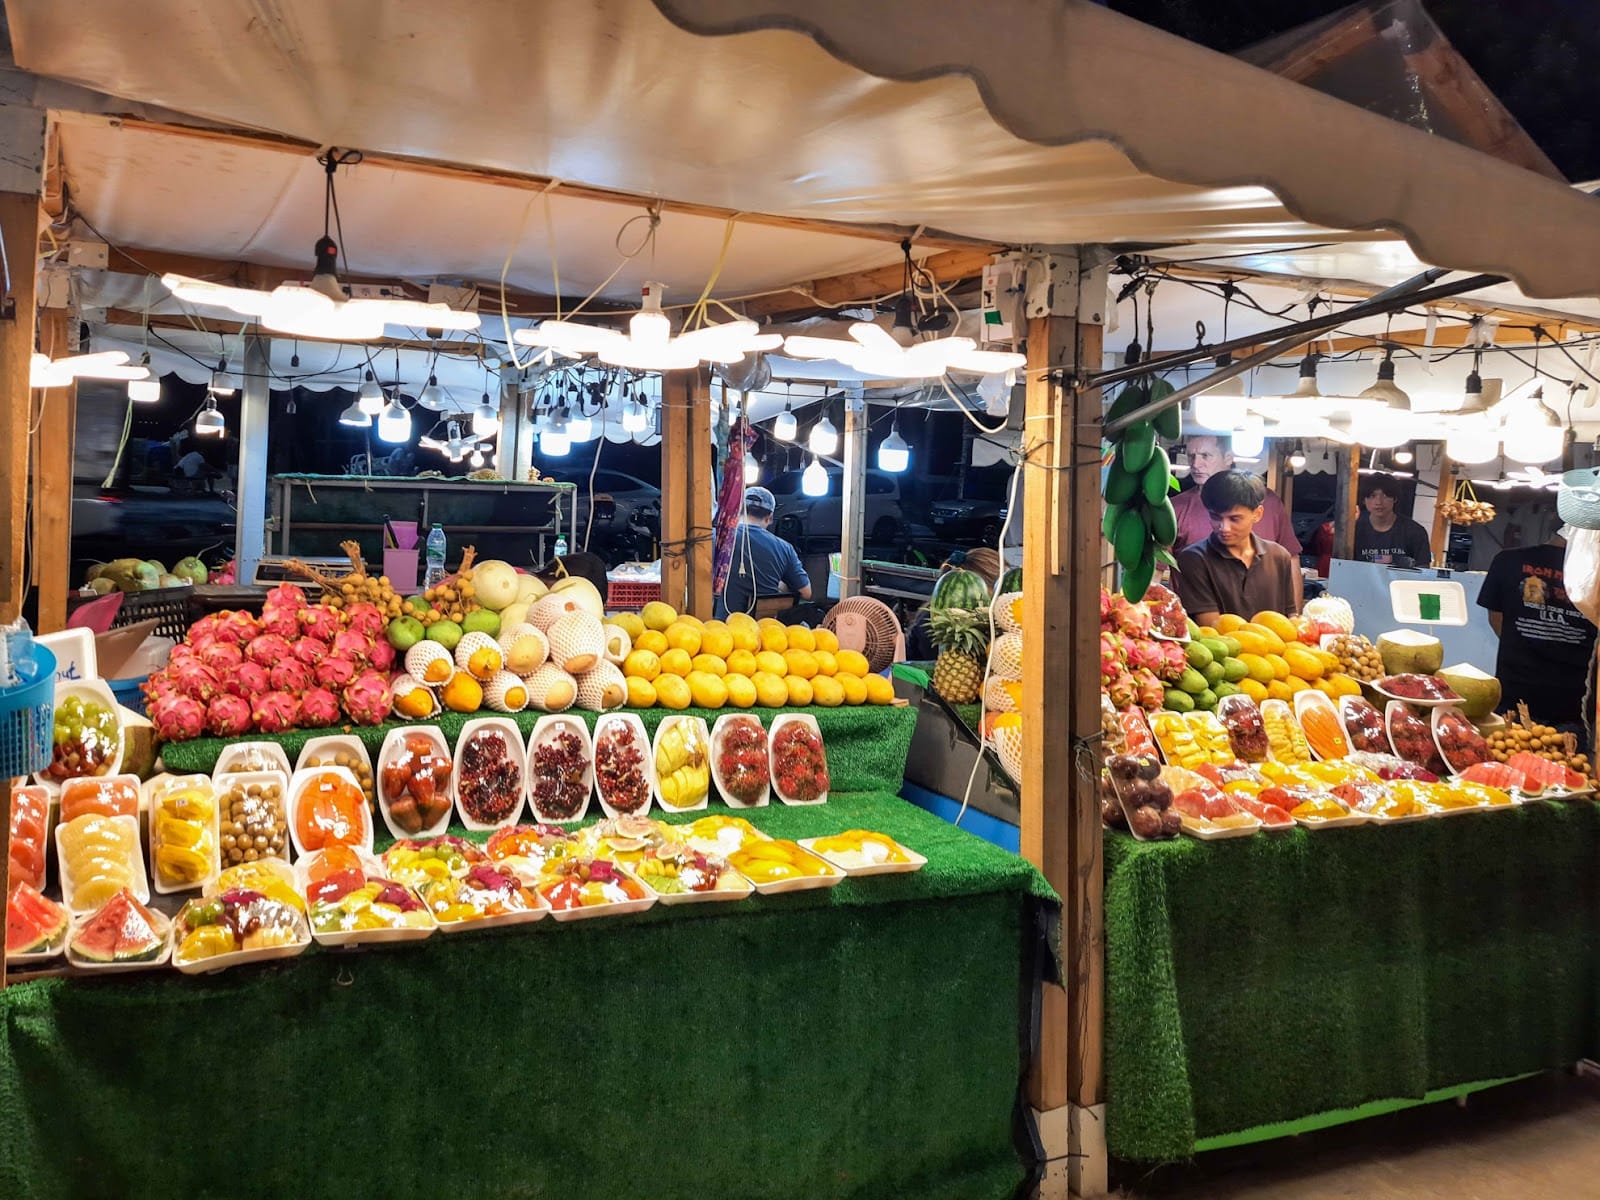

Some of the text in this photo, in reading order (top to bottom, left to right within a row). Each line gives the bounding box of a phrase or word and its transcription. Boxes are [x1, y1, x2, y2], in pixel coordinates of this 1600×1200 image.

[1523, 564, 1552, 577] IRON
[1523, 601, 1546, 610] WORLD
[1547, 605, 1565, 614] TOUR
[1539, 610, 1569, 625] U.S.A.
